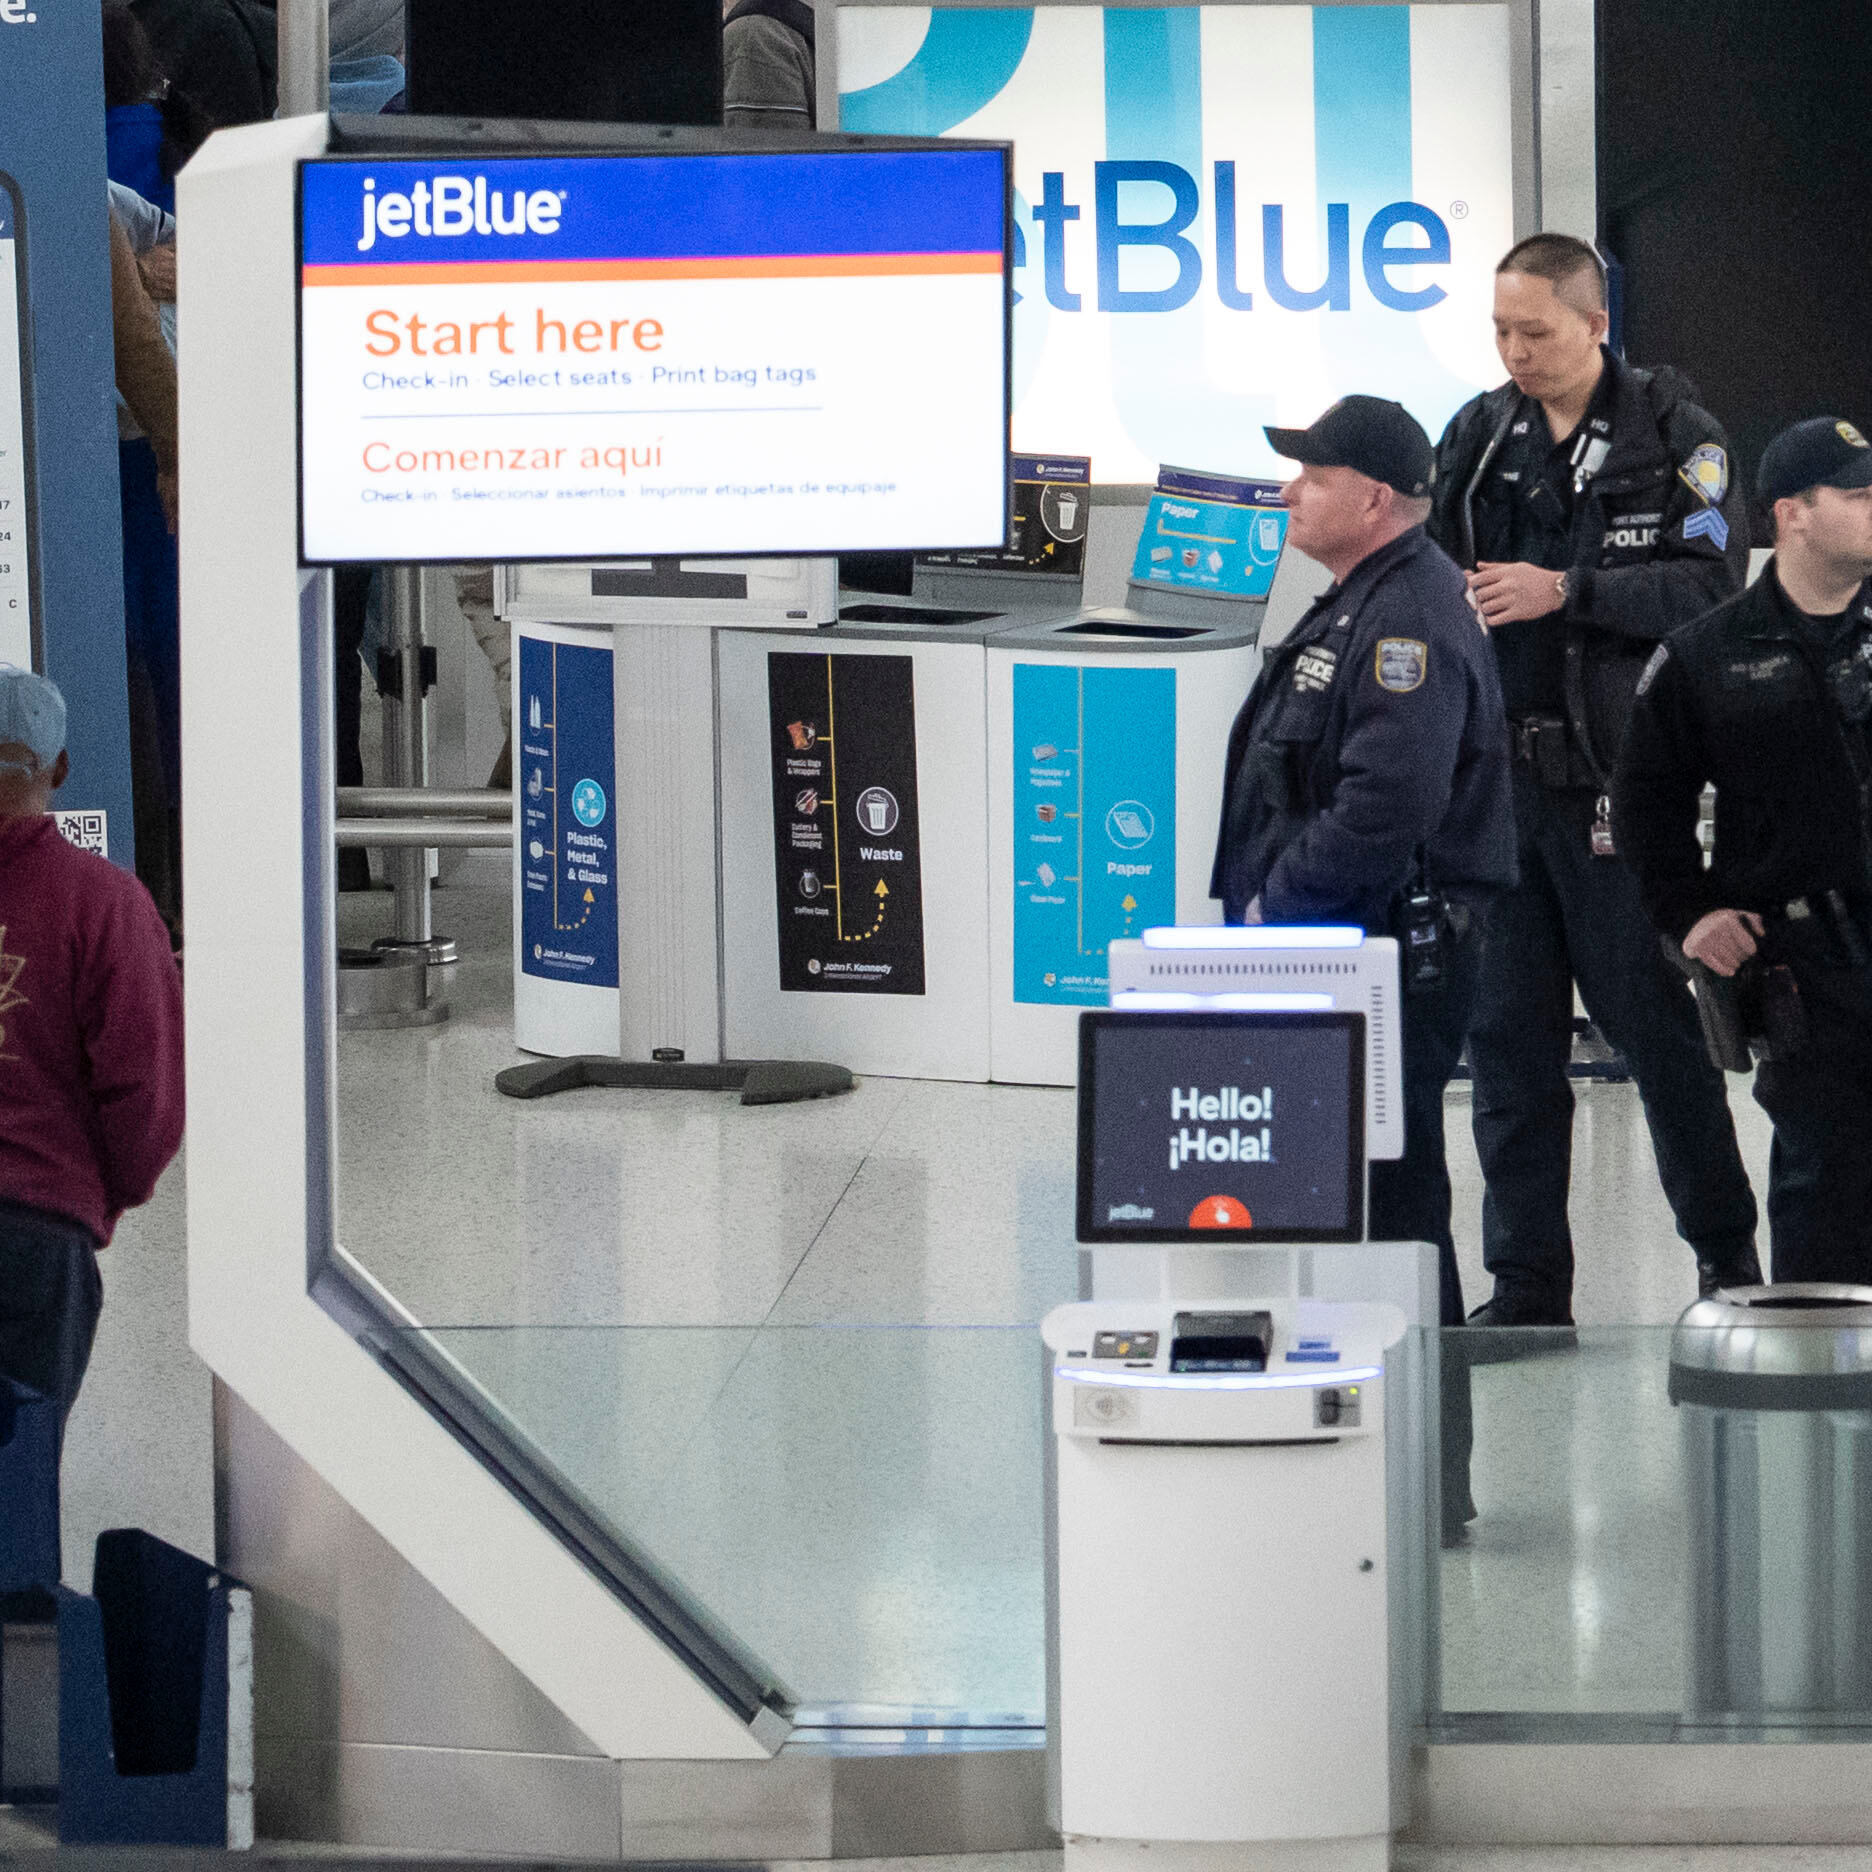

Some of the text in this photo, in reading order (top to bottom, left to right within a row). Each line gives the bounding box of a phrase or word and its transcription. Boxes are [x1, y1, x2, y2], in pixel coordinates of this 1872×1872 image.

[358, 176, 562, 251] jetBlue
[1012, 160, 1452, 313] tBlue
[366, 309, 663, 356] Start here
[362, 372, 468, 390] Check-in
[489, 370, 632, 387] Select seats
[653, 366, 816, 387] Print bag tags
[363, 436, 660, 476] Comenzar aquí
[361, 489, 436, 502] Check-in
[452, 487, 625, 500] Seleccionar asientos
[641, 482, 896, 499] Imprimir etiquetas de equipaje
[1160, 502, 1199, 519] Paper
[1603, 528, 1659, 549] POLIC
[567, 832, 607, 849] Plastic,
[568, 850, 599, 867] Metal,
[860, 848, 902, 860] Waste
[568, 868, 607, 884] & Glass
[1107, 862, 1152, 877] Paper
[543, 947, 558, 958] John
[565, 951, 595, 965] Kennedy
[823, 962, 845, 973] John
[854, 963, 892, 976] Kennedy
[1172, 1087, 1272, 1120] Hello!
[1170, 1128, 1270, 1169] ¡Hola!
